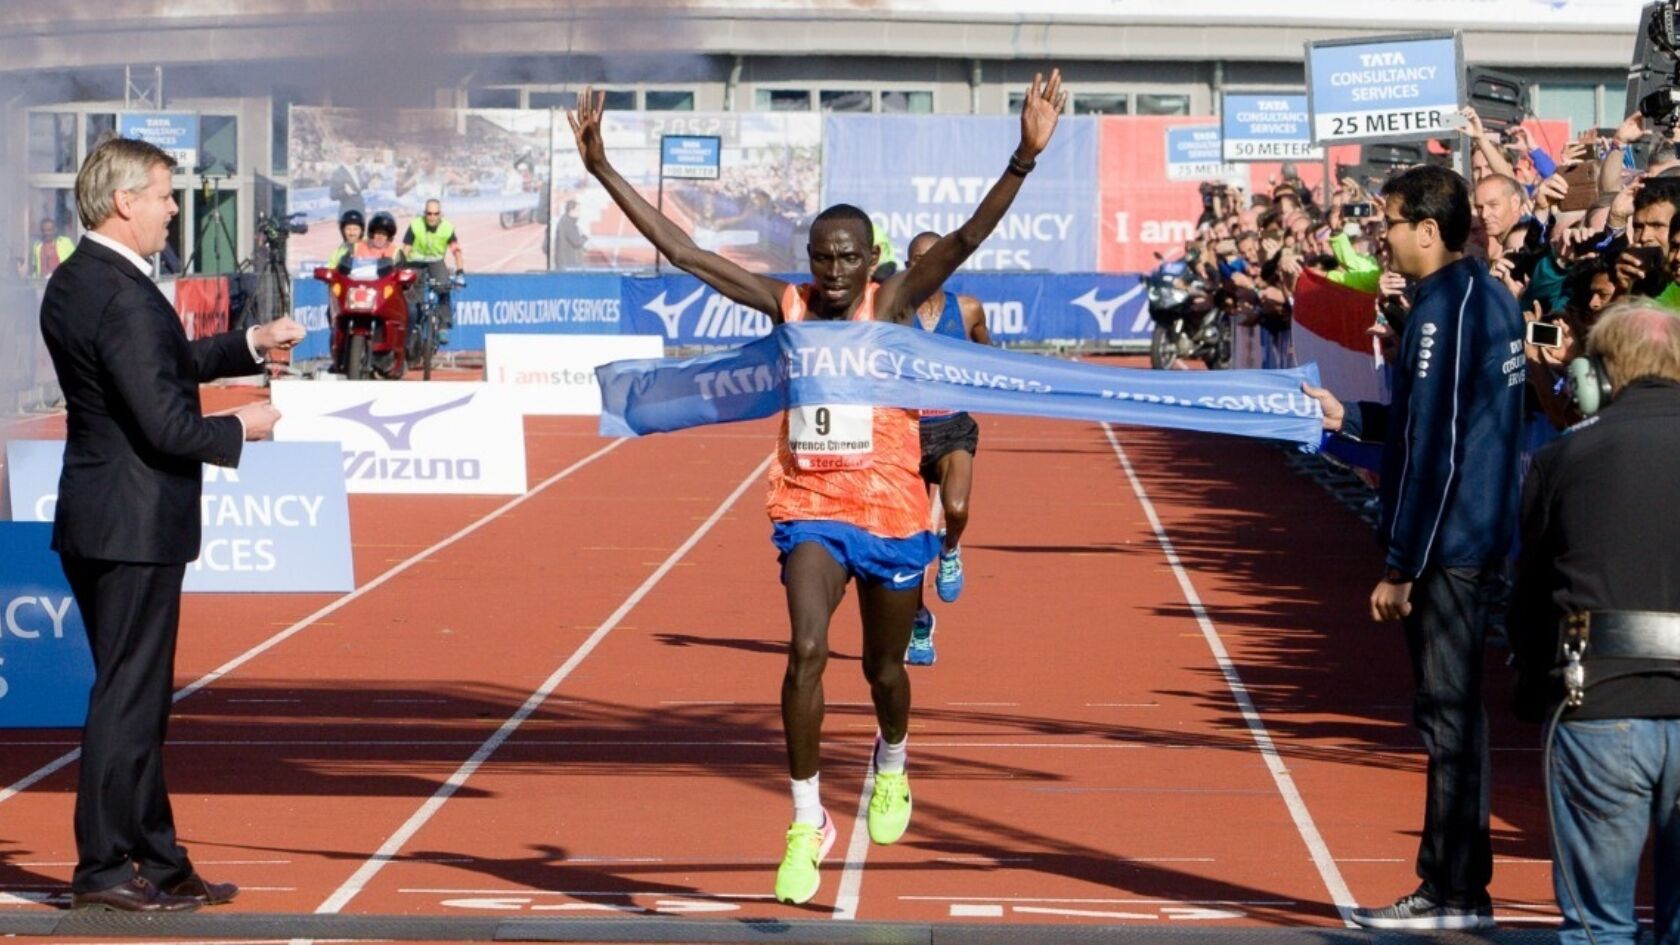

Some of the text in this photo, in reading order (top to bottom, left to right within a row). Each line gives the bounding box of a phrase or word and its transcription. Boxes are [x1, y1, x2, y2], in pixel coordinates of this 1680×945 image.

[1360, 52, 1406, 67] TATA
[1331, 66, 1437, 87] CONSULTANCY
[1352, 84, 1420, 101] SERVICES
[1256, 100, 1289, 111] TATA
[1250, 123, 1297, 134] SERVICES
[1332, 110, 1441, 135] 25 METER
[1235, 143, 1311, 155] 50 METER
[911, 177, 1001, 203] TAT
[456, 298, 620, 325] TATA CONSULTANCY SERVICES
[515, 369, 597, 385] amster
[694, 364, 773, 400] TATA
[815, 407, 831, 436] 9
